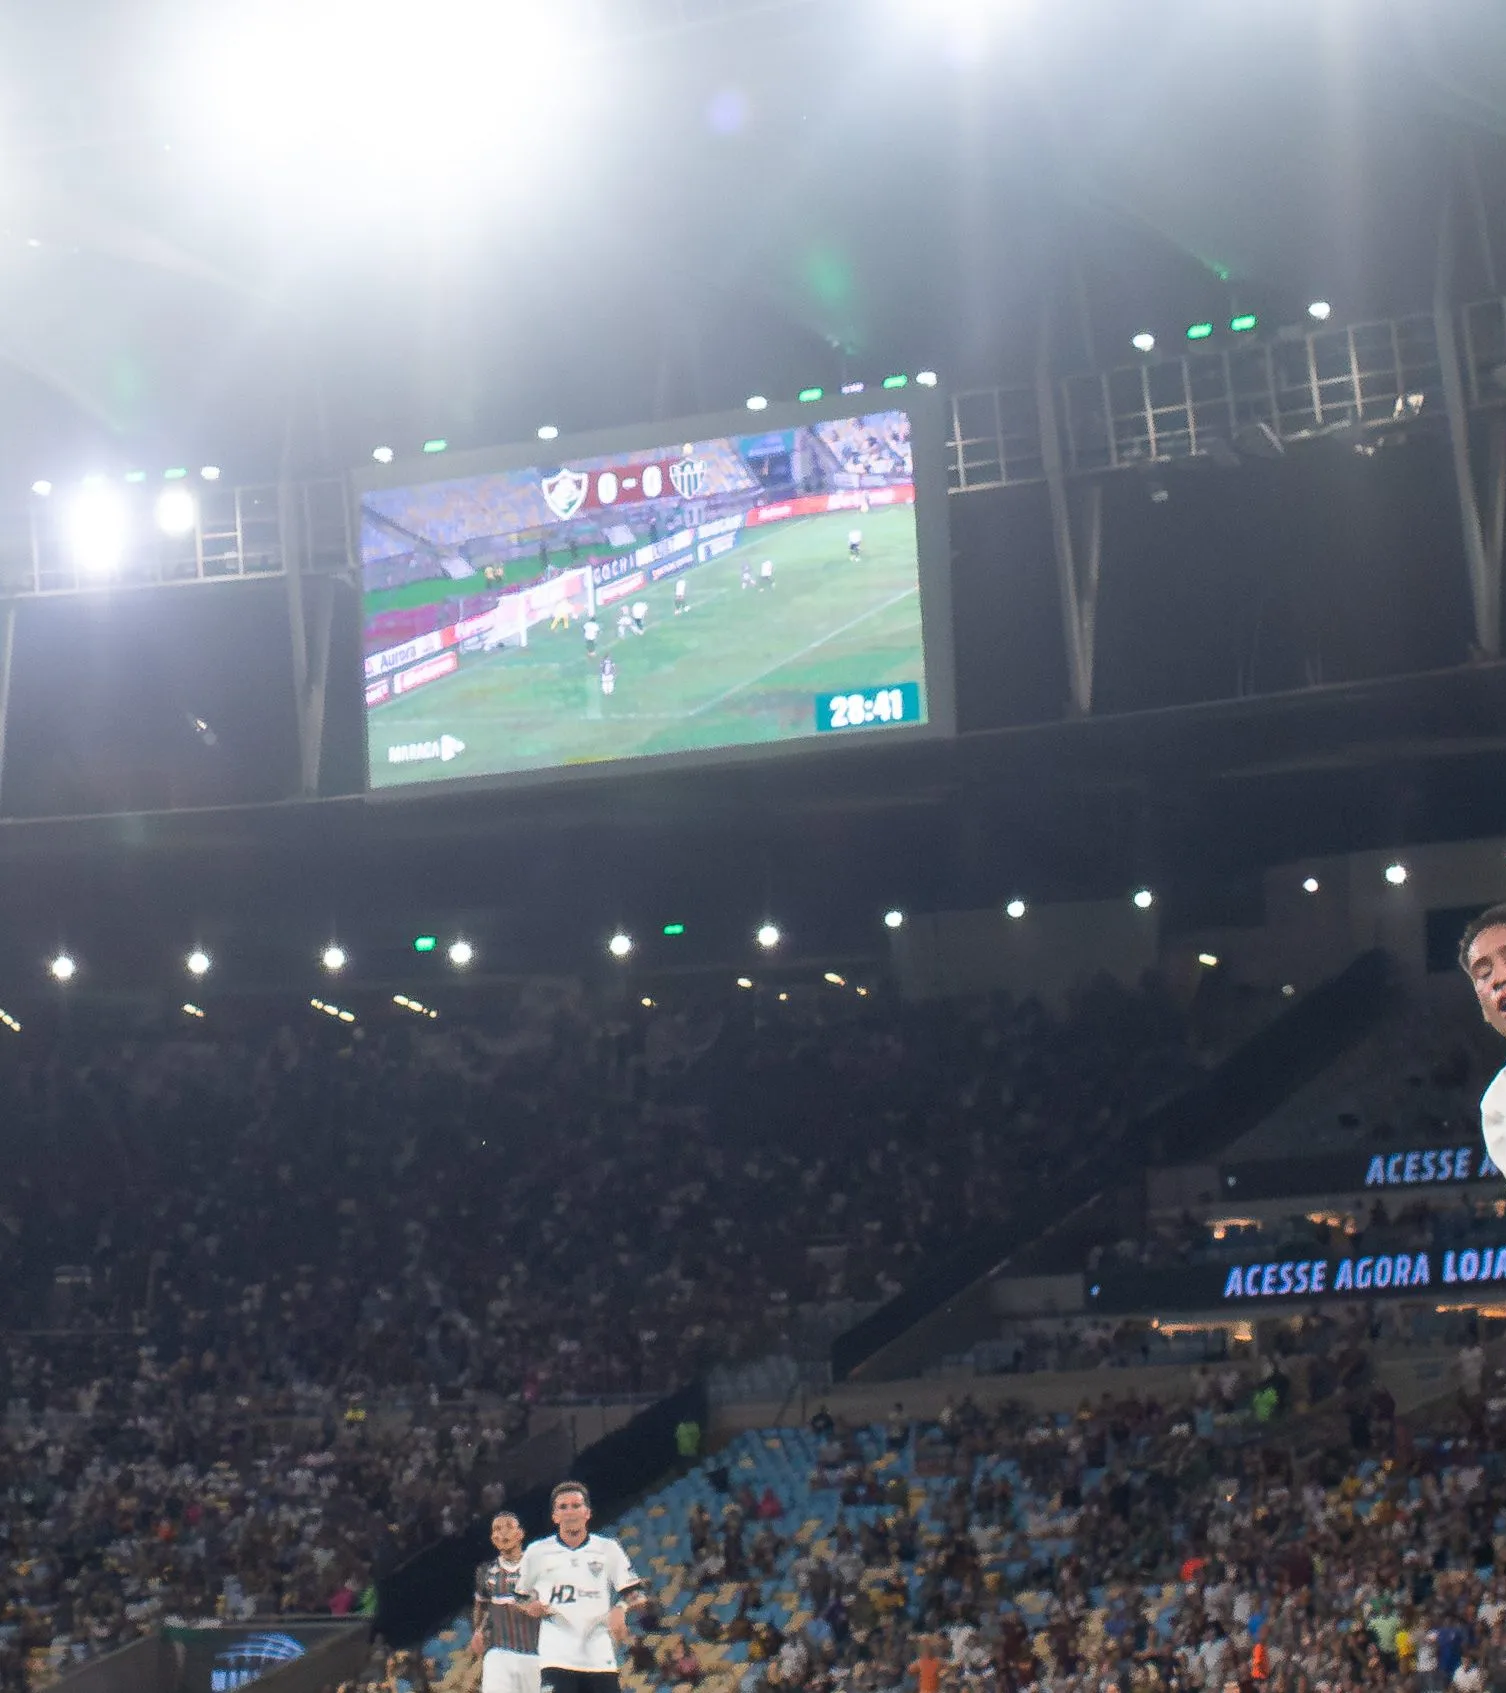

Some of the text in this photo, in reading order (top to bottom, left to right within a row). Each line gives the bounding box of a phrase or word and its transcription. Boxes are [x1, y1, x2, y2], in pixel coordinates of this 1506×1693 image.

[829, 688, 903, 728] 28:41
[1364, 1148, 1473, 1186] ACESSE
[1224, 1259, 1329, 1297] ACESSE
[1334, 1252, 1432, 1290] AGORA
